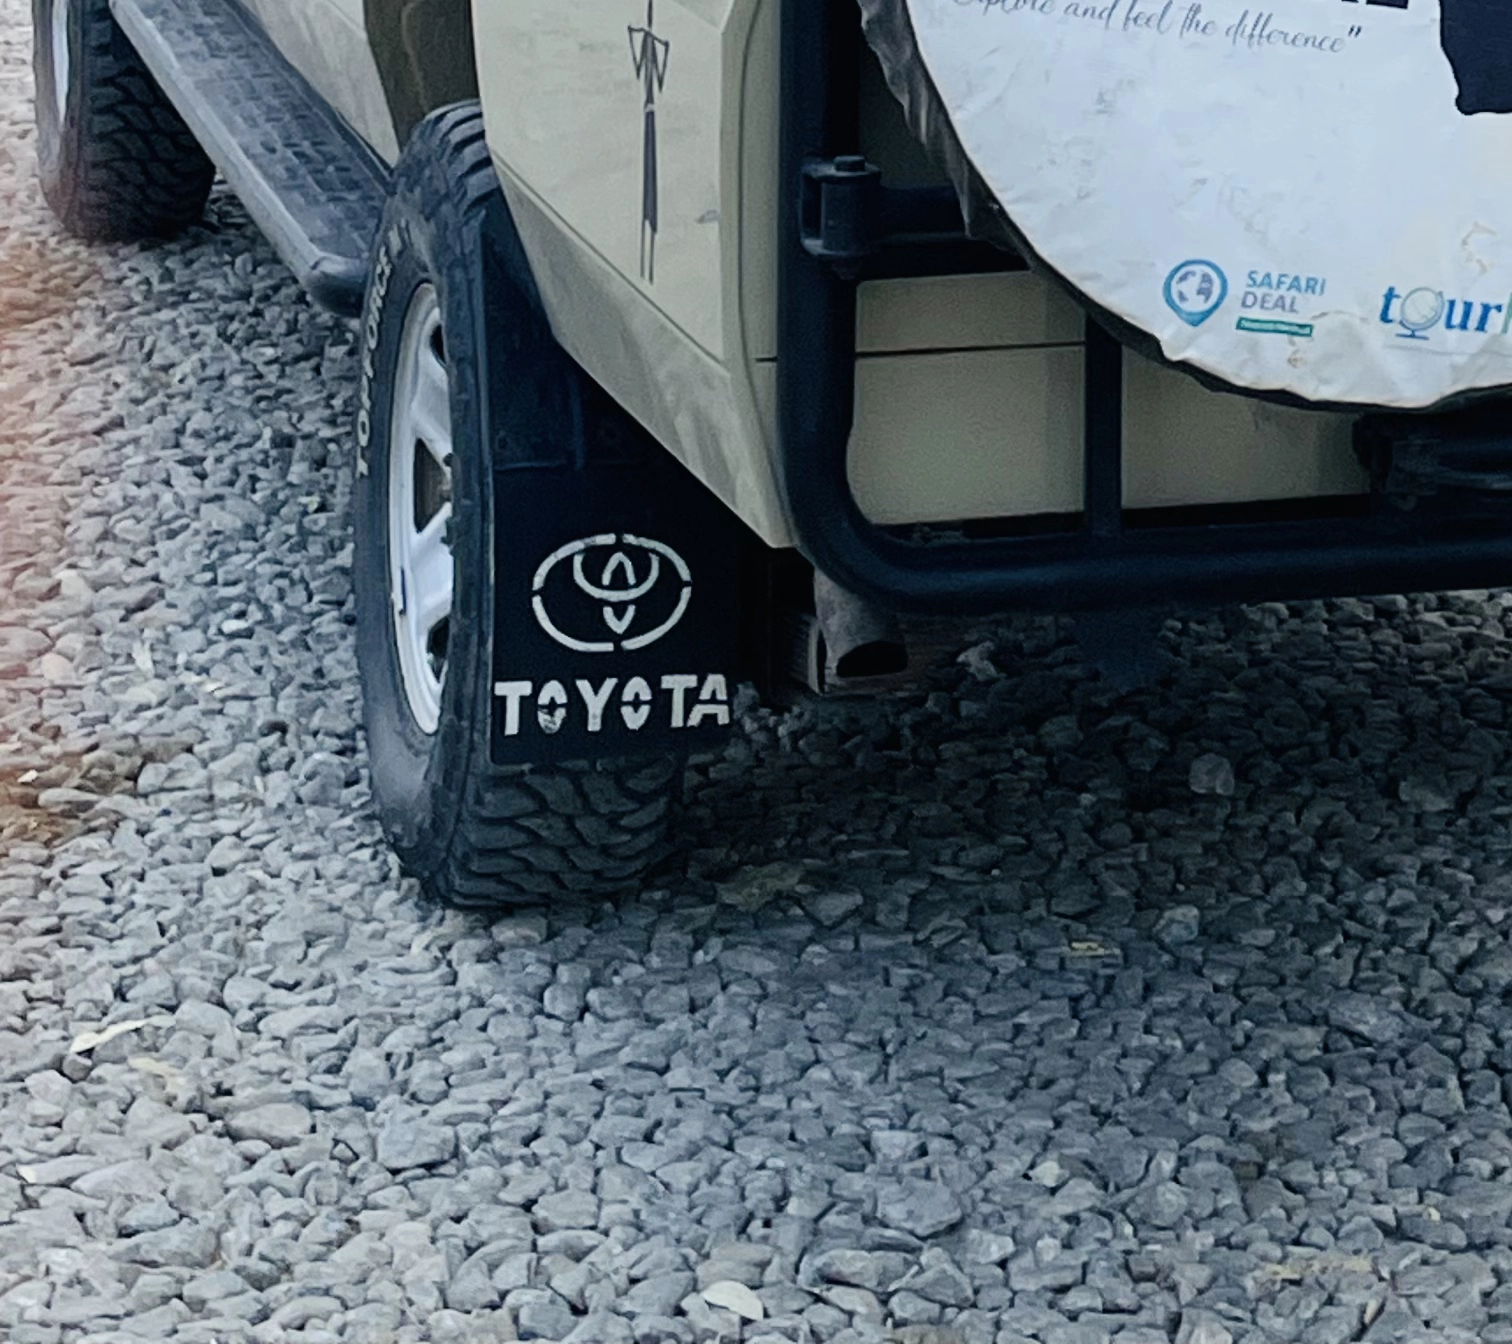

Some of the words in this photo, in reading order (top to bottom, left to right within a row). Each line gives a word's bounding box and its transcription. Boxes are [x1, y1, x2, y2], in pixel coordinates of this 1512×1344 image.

[1178, 2, 1217, 40] the
[1246, 270, 1327, 297] SAFARI
[1241, 292, 1299, 314] DEAL
[494, 673, 730, 736] TOYOTA
